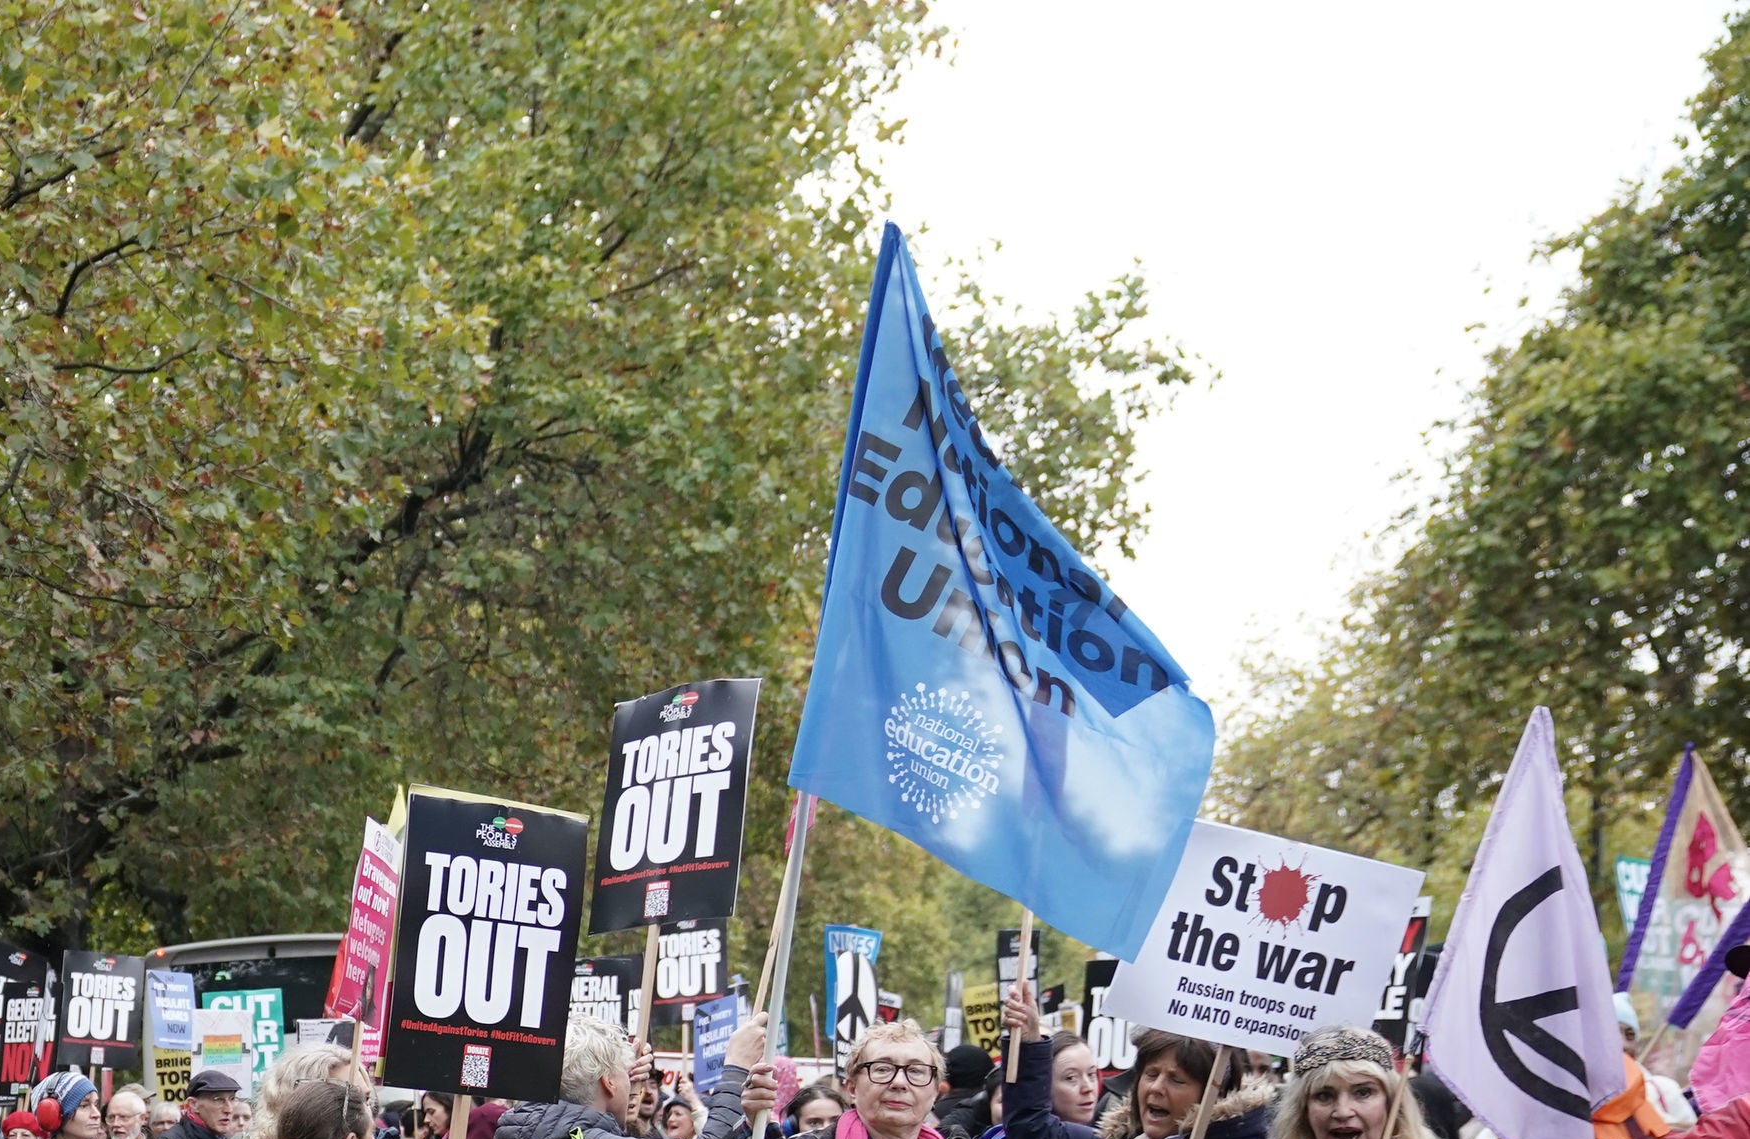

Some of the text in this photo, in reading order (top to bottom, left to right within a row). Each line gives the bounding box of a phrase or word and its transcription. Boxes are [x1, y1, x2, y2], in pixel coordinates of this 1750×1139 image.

[914, 713, 980, 754] national
[621, 721, 736, 789] TORIES
[884, 717, 1000, 795] education
[910, 760, 949, 790] union
[480, 823, 495, 832] THE
[609, 771, 731, 872] OUT
[483, 839, 517, 850] ASSEMBLY
[361, 854, 397, 898] Braverman
[425, 851, 567, 928] TORIES
[357, 884, 389, 917] out now!
[352, 907, 387, 946] Refugees
[350, 937, 381, 969] welcome
[658, 928, 721, 959] TORIES
[1166, 911, 1240, 972] the
[1255, 941, 1356, 996] war
[70, 972, 136, 1001] TORIES
[346, 956, 366, 986] here
[414, 914, 561, 1029] OUT
[656, 953, 721, 999] OUT
[6, 997, 57, 1022] GENERL
[966, 1002, 1000, 1015] BRIN
[1177, 976, 1317, 1021] Russian troops out
[5, 1020, 56, 1043] ELECTN
[67, 996, 135, 1042] OUT
[167, 1024, 186, 1034] NOW
[401, 1019, 556, 1046] #UnitedAgainstTories #NotFitToGovern
[968, 1020, 996, 1034] TO
[1167, 999, 1309, 1041] No NATO expansio
[467, 1046, 489, 1056] DONATE
[981, 1037, 1001, 1051] DO
[1088, 1016, 1139, 1070] OU
[155, 1057, 191, 1068] BRING
[157, 1071, 191, 1085] TOR
[164, 1088, 188, 1102] DO
